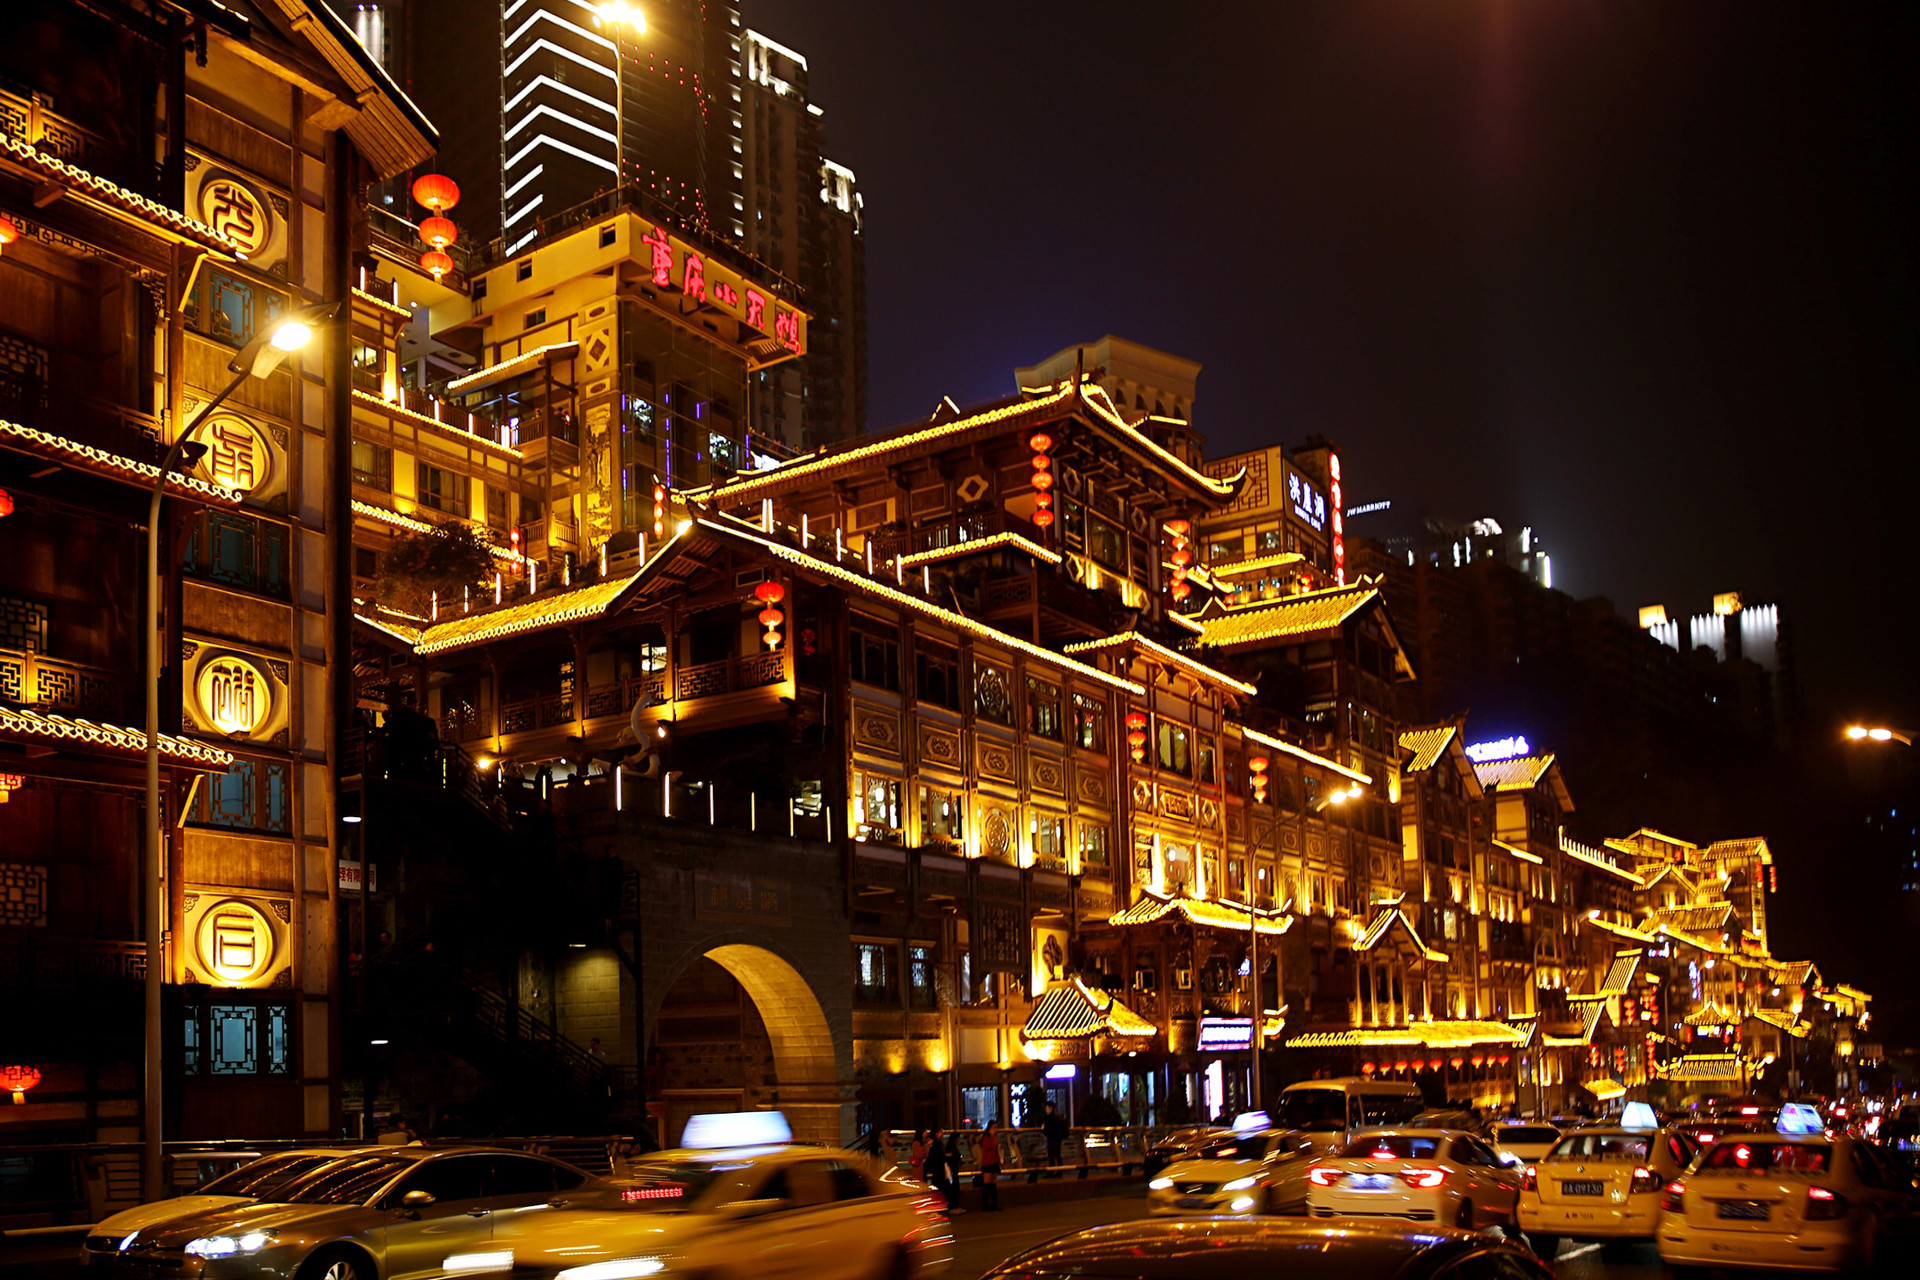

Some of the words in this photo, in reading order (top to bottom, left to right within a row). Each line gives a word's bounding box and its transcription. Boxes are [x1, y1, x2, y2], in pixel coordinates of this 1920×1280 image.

[1288, 472, 1325, 524] 洪崖洞
[339, 866, 375, 886] 理有限司
